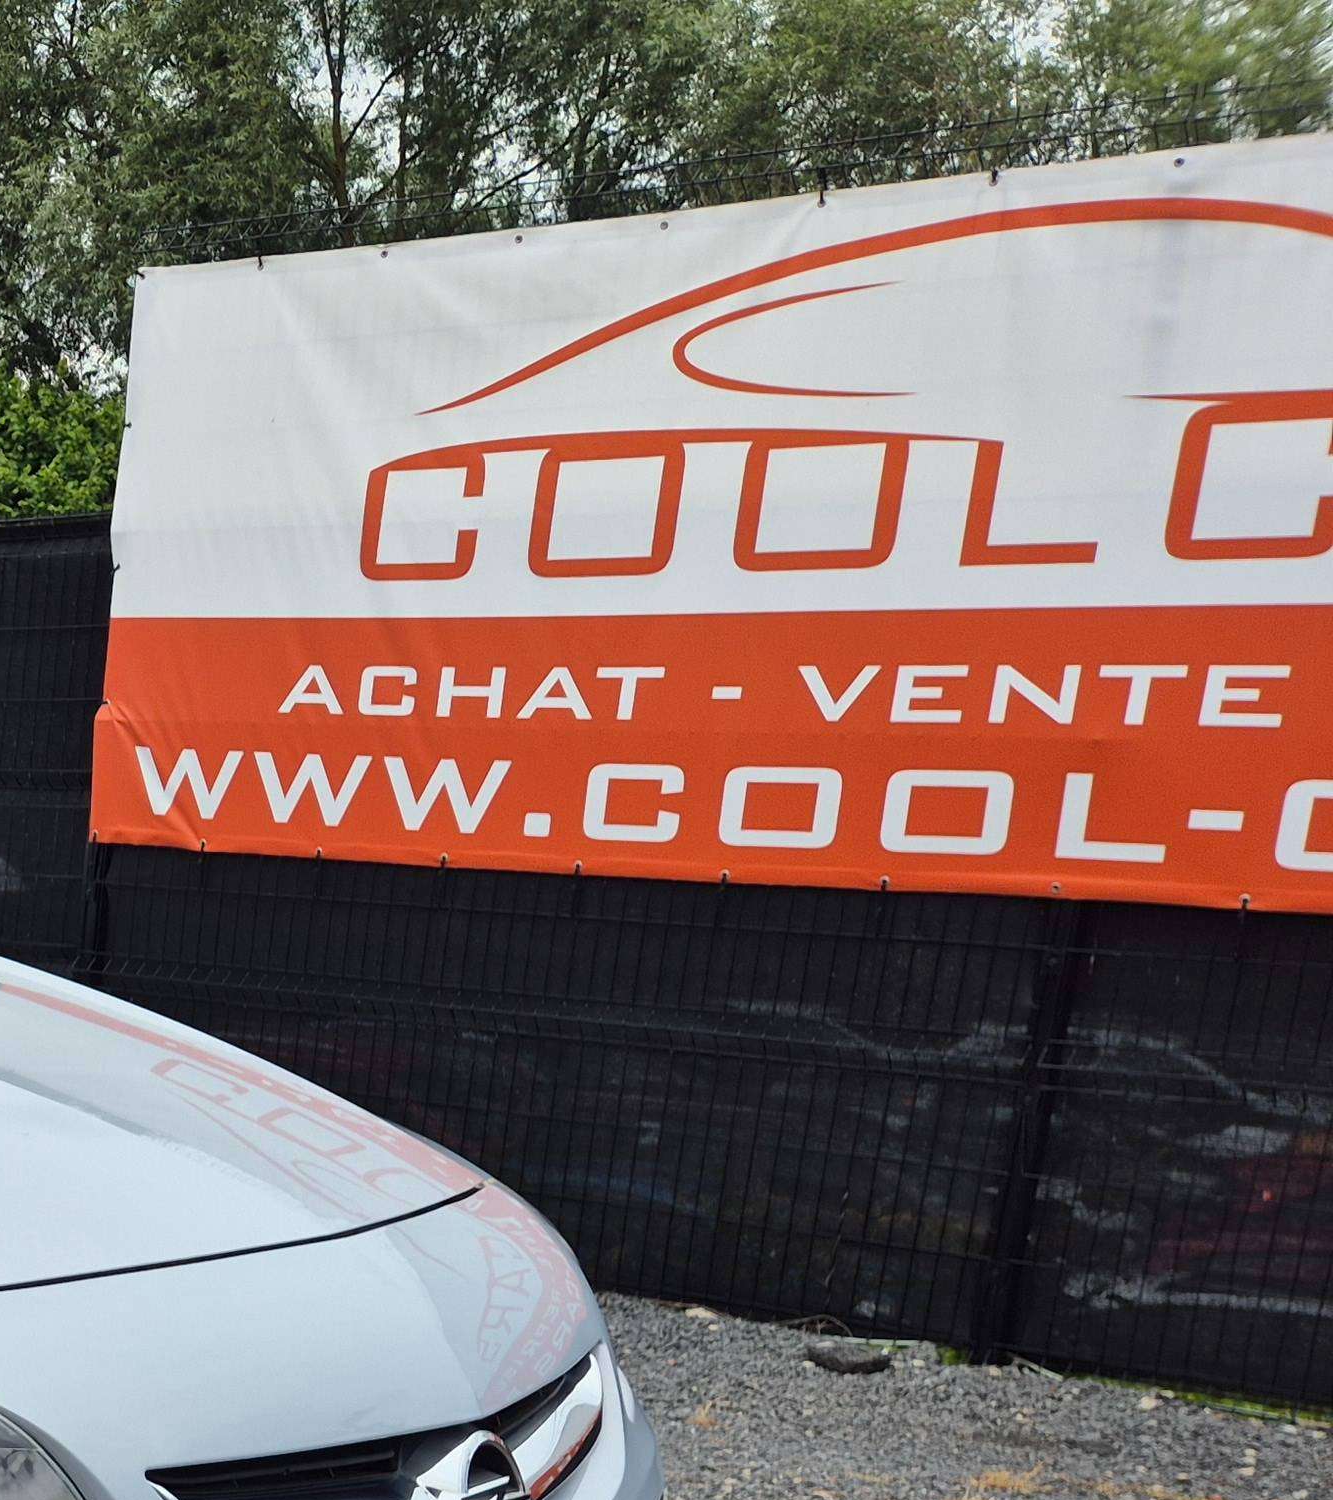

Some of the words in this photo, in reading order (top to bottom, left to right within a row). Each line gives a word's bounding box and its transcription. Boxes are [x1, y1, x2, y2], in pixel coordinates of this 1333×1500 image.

[360, 428, 1098, 582] COOL
[277, 664, 666, 721] ACHAT
[711, 686, 743, 701] -
[798, 663, 1292, 728] VENTE
